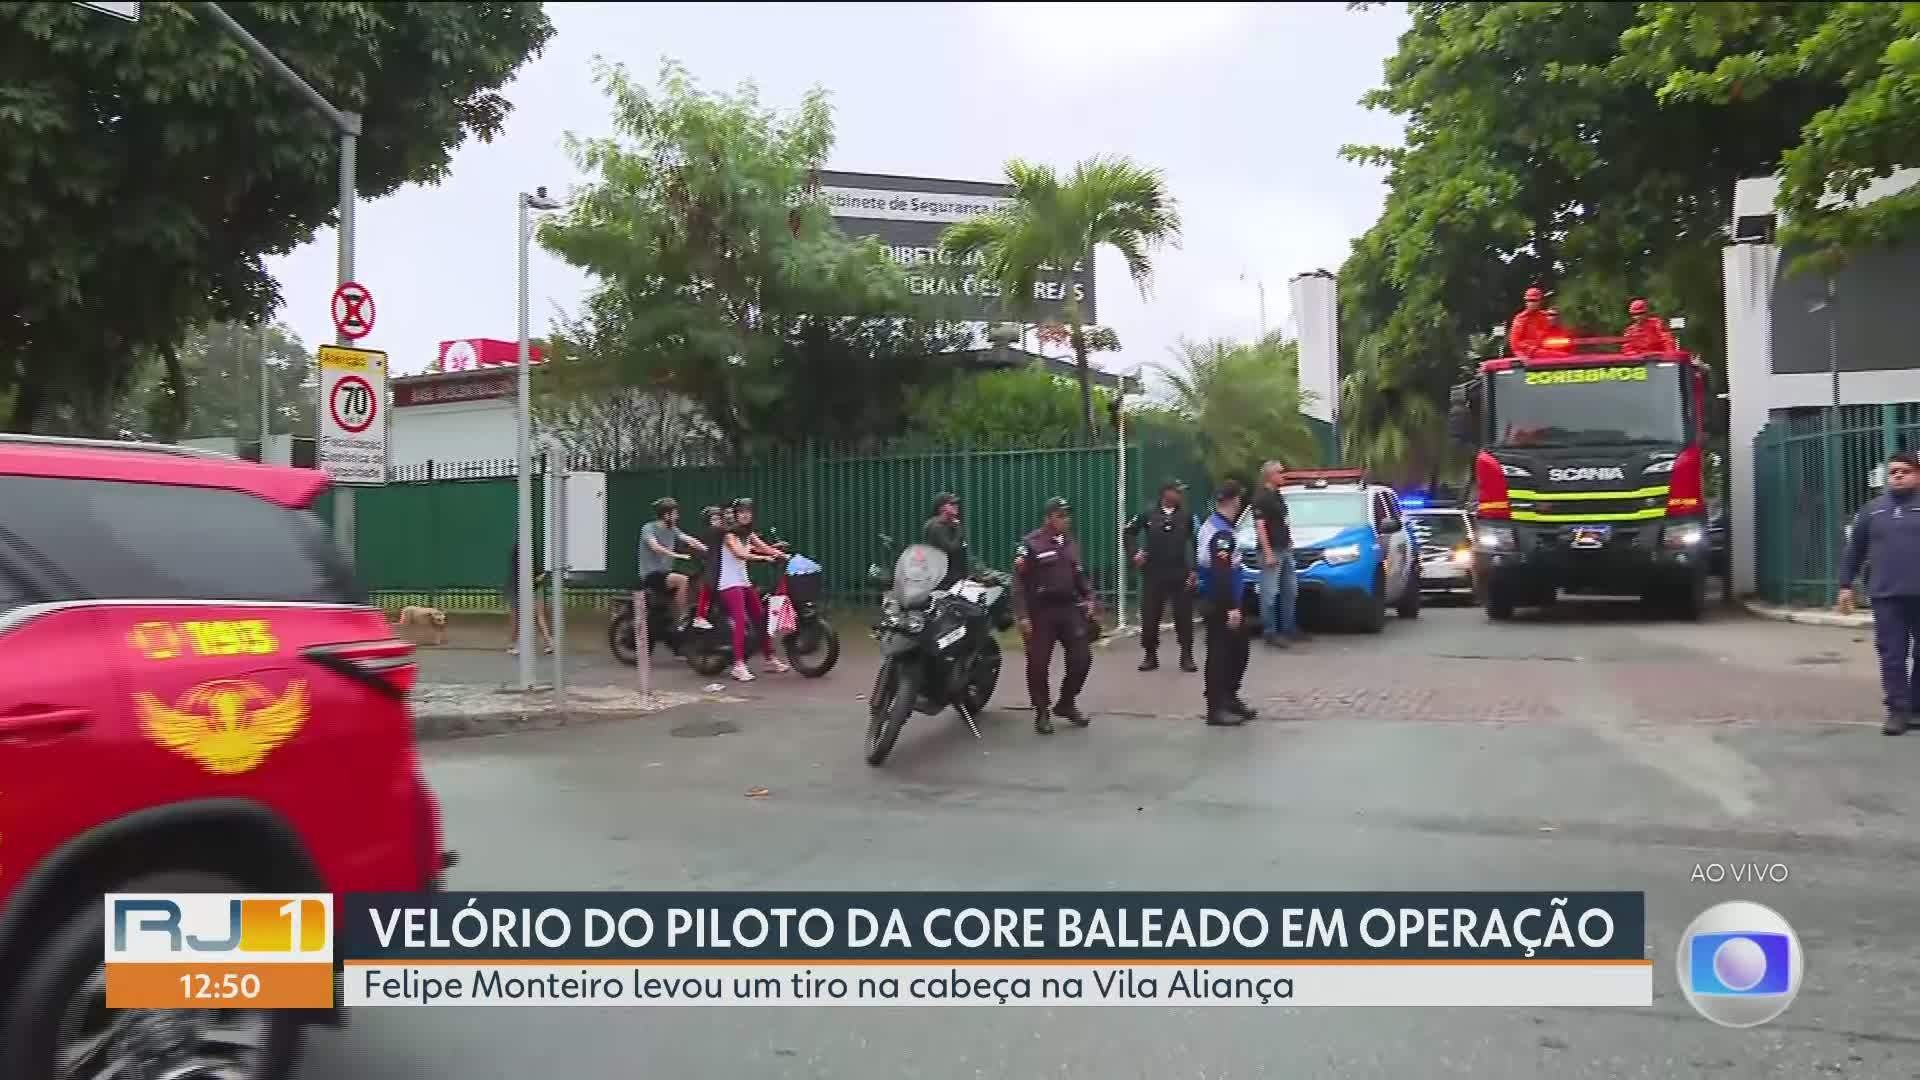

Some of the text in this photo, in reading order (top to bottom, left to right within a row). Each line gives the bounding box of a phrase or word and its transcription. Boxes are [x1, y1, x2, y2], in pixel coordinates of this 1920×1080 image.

[889, 195, 909, 212] de
[341, 386, 367, 415] 70
[1548, 467, 1625, 481] SCANIA
[177, 619, 279, 656] 193
